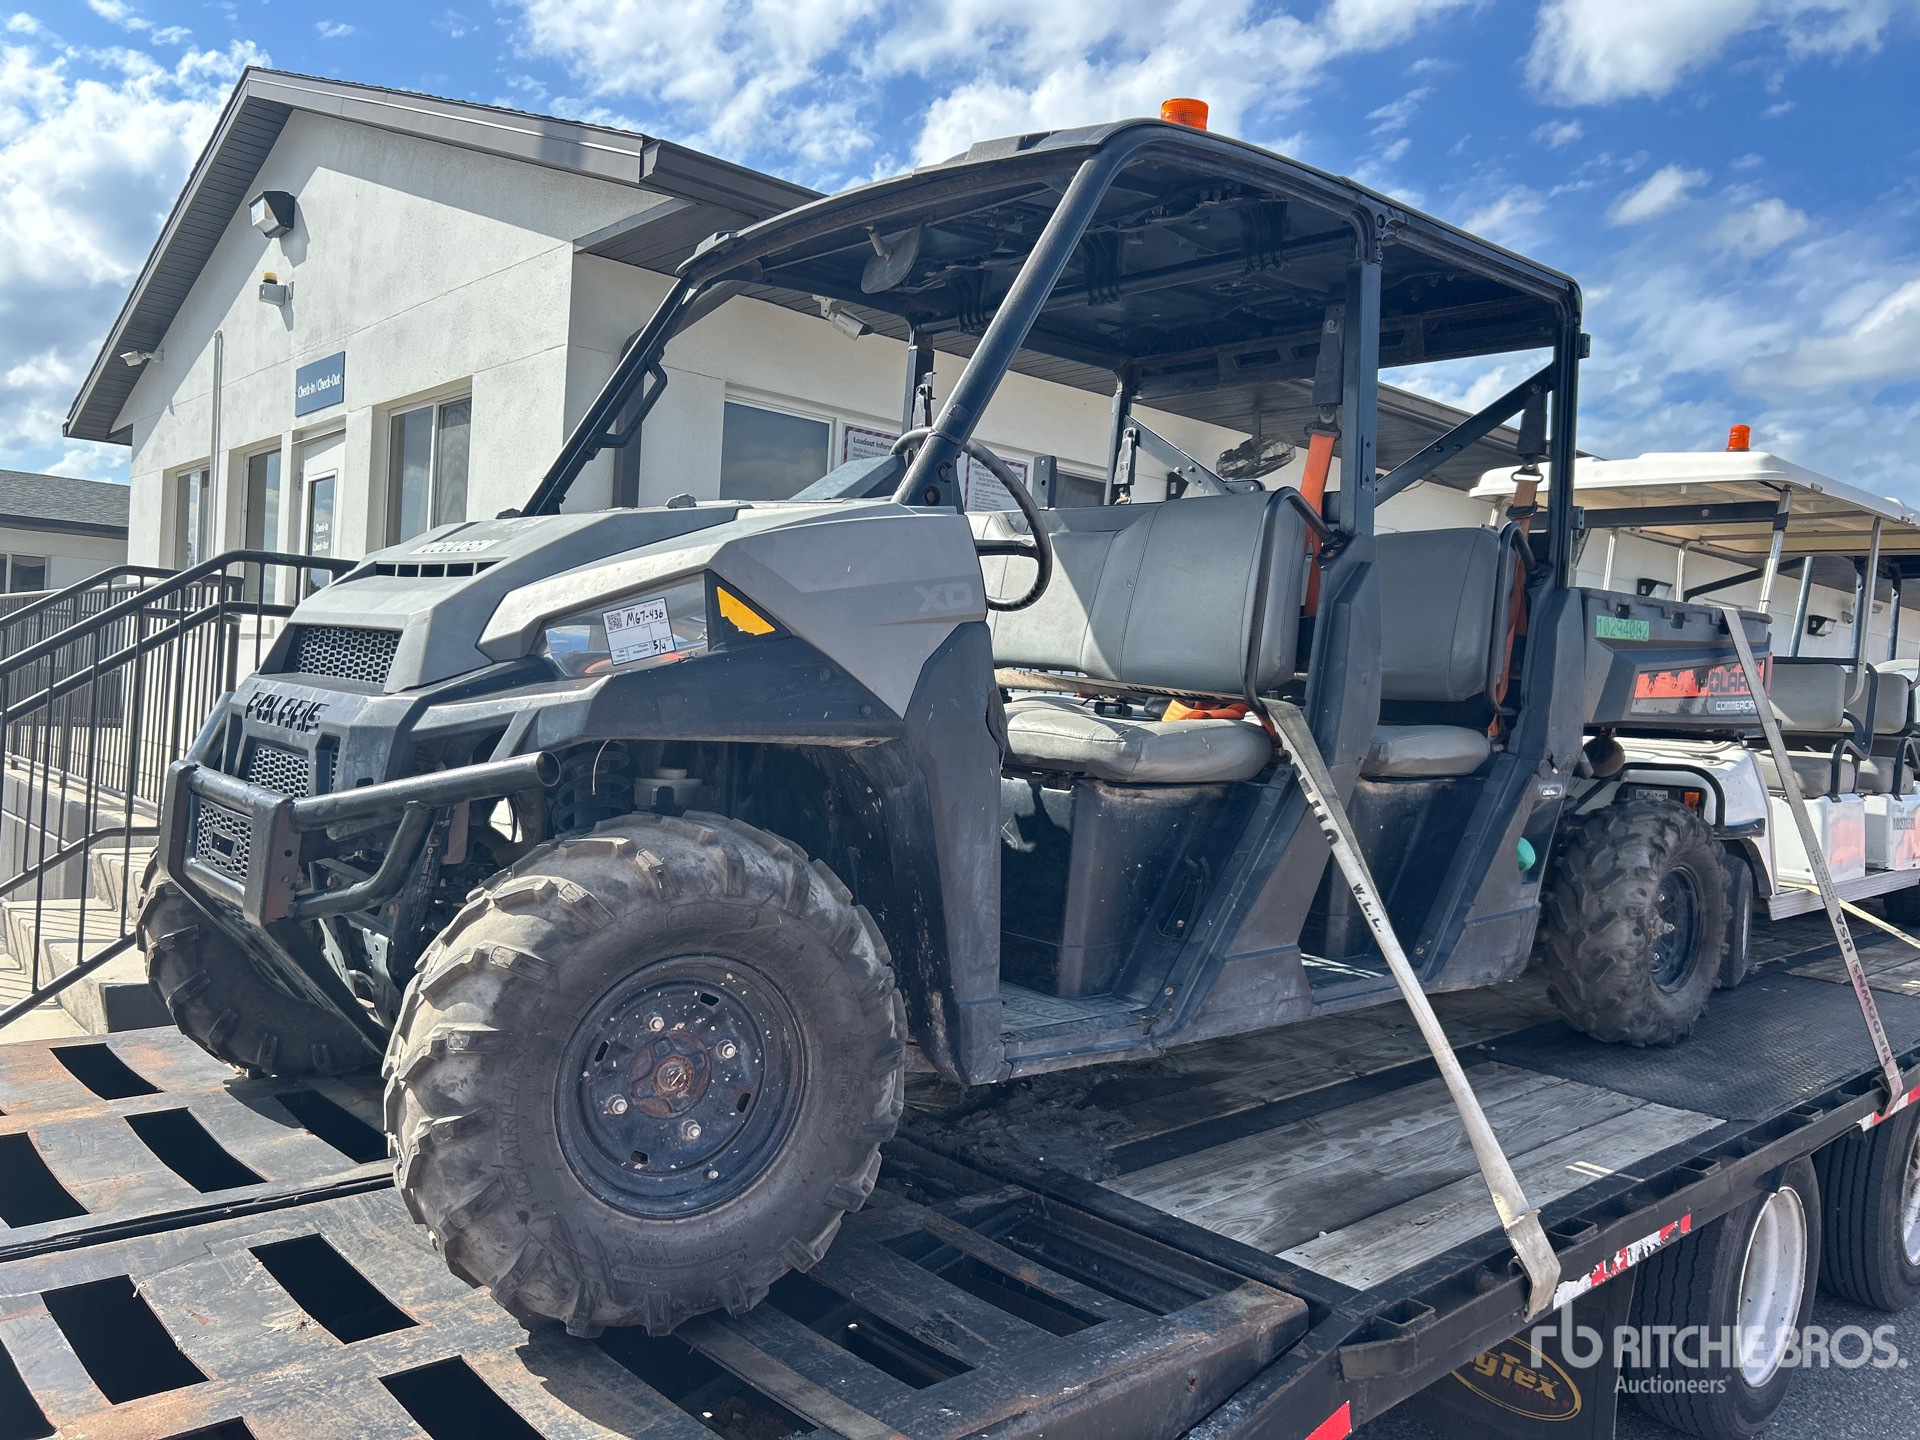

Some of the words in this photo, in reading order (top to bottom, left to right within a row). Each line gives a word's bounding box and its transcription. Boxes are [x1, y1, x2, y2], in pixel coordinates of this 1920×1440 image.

[298, 382, 315, 398] Check-In
[318, 373, 340, 391] Check-Out
[853, 437, 875, 447] Loadout
[876, 441, 893, 450] Inform
[913, 582, 973, 612] XD
[1597, 617, 1648, 639] 10294082
[1698, 672, 1750, 693] POLAR
[245, 692, 330, 735] POLARIS
[1716, 700, 1756, 711] COMMERCIA
[1835, 912, 1852, 953] USA
[1473, 1351, 1560, 1400] gTex
